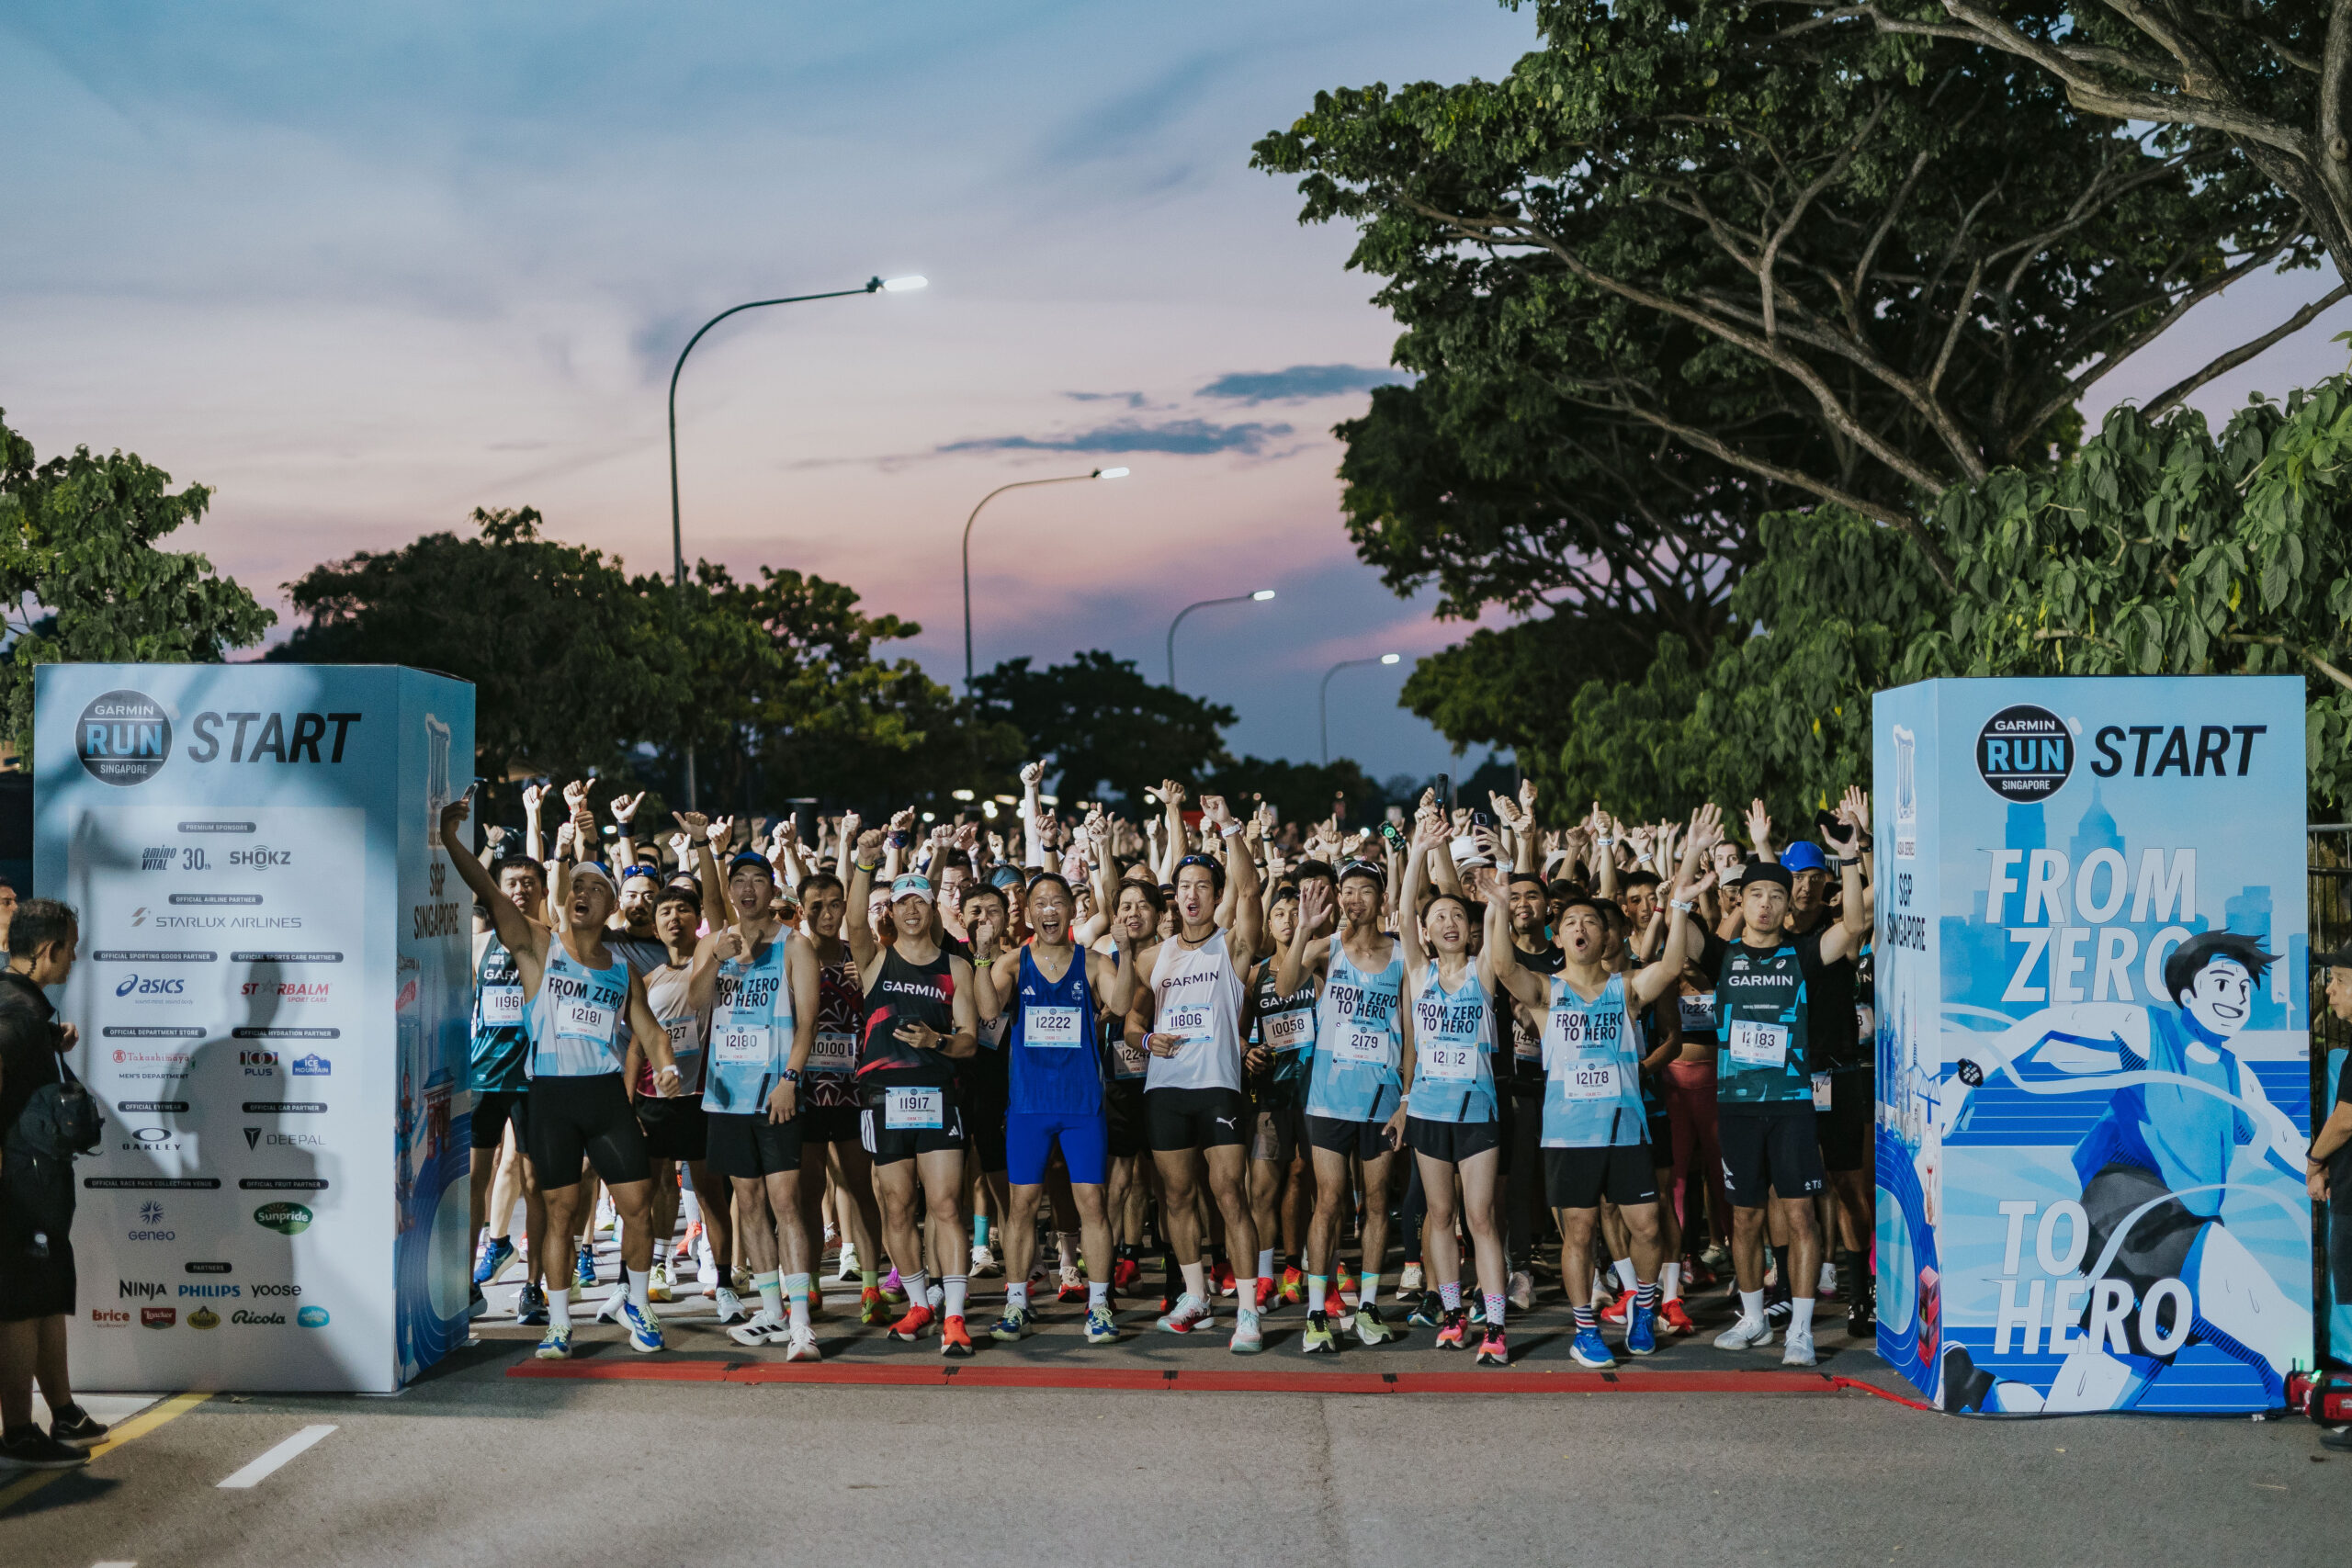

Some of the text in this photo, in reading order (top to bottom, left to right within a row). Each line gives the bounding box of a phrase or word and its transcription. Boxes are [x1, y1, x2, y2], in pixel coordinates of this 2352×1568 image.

[95, 705, 153, 715] GARMIN
[1995, 720, 2055, 730] GARMIN
[86, 724, 162, 755] RUN
[187, 712, 361, 763] START
[1986, 739, 2064, 771] RUN
[2090, 725, 2267, 778] START
[100, 764, 147, 773] SINGAPORE
[2002, 780, 2050, 790] SINGAPORE
[142, 844, 176, 859] amino
[230, 851, 291, 865] SHOKZ
[141, 858, 168, 870] VITAL
[429, 863, 445, 897] SGP
[1977, 847, 2197, 924] FROM
[1898, 873, 1912, 908] SGP
[156, 917, 301, 928] STARLUX AIRLINES
[414, 902, 459, 940] SINGAPORE
[1888, 911, 1926, 952] SINGAPORE
[2000, 926, 2194, 1003] ZERO
[138, 978, 185, 994] asics
[747, 977, 779, 993] ZERO
[1161, 970, 1219, 988] GARMIN
[1728, 975, 1792, 987] GARMIN
[548, 976, 588, 998] FROM
[592, 986, 625, 1009] ZERO
[883, 980, 946, 1001] GARMIN
[1330, 985, 1397, 1009] FROM ZERO
[495, 996, 524, 1008] 11961
[719, 992, 768, 1007] TO HERO
[571, 1008, 602, 1024] 12181
[1338, 1000, 1385, 1020] TO HERO
[1418, 1003, 1484, 1021] FROM ZERO
[1682, 1003, 1713, 1014] 12224
[1035, 1016, 1071, 1029] 12222
[1170, 1013, 1202, 1027] 11806
[1272, 1019, 1305, 1035] 10058
[1423, 1017, 1475, 1033] TO HERO
[1556, 1013, 1590, 1028] FROM
[726, 1034, 757, 1047] 12180
[1565, 1026, 1616, 1042] TO HERO
[128, 1052, 190, 1064] Takashimaya
[1576, 1071, 1609, 1085] 12178
[900, 1097, 929, 1109] 11917
[266, 1134, 326, 1145] DEEPAL
[258, 1212, 309, 1224] Sunpride
[1998, 1199, 2089, 1276] TO
[119, 1280, 301, 1301] NINJA PHILIPS yoose
[232, 1310, 286, 1324] Ricola
[1981, 1279, 2193, 1356] HERO
